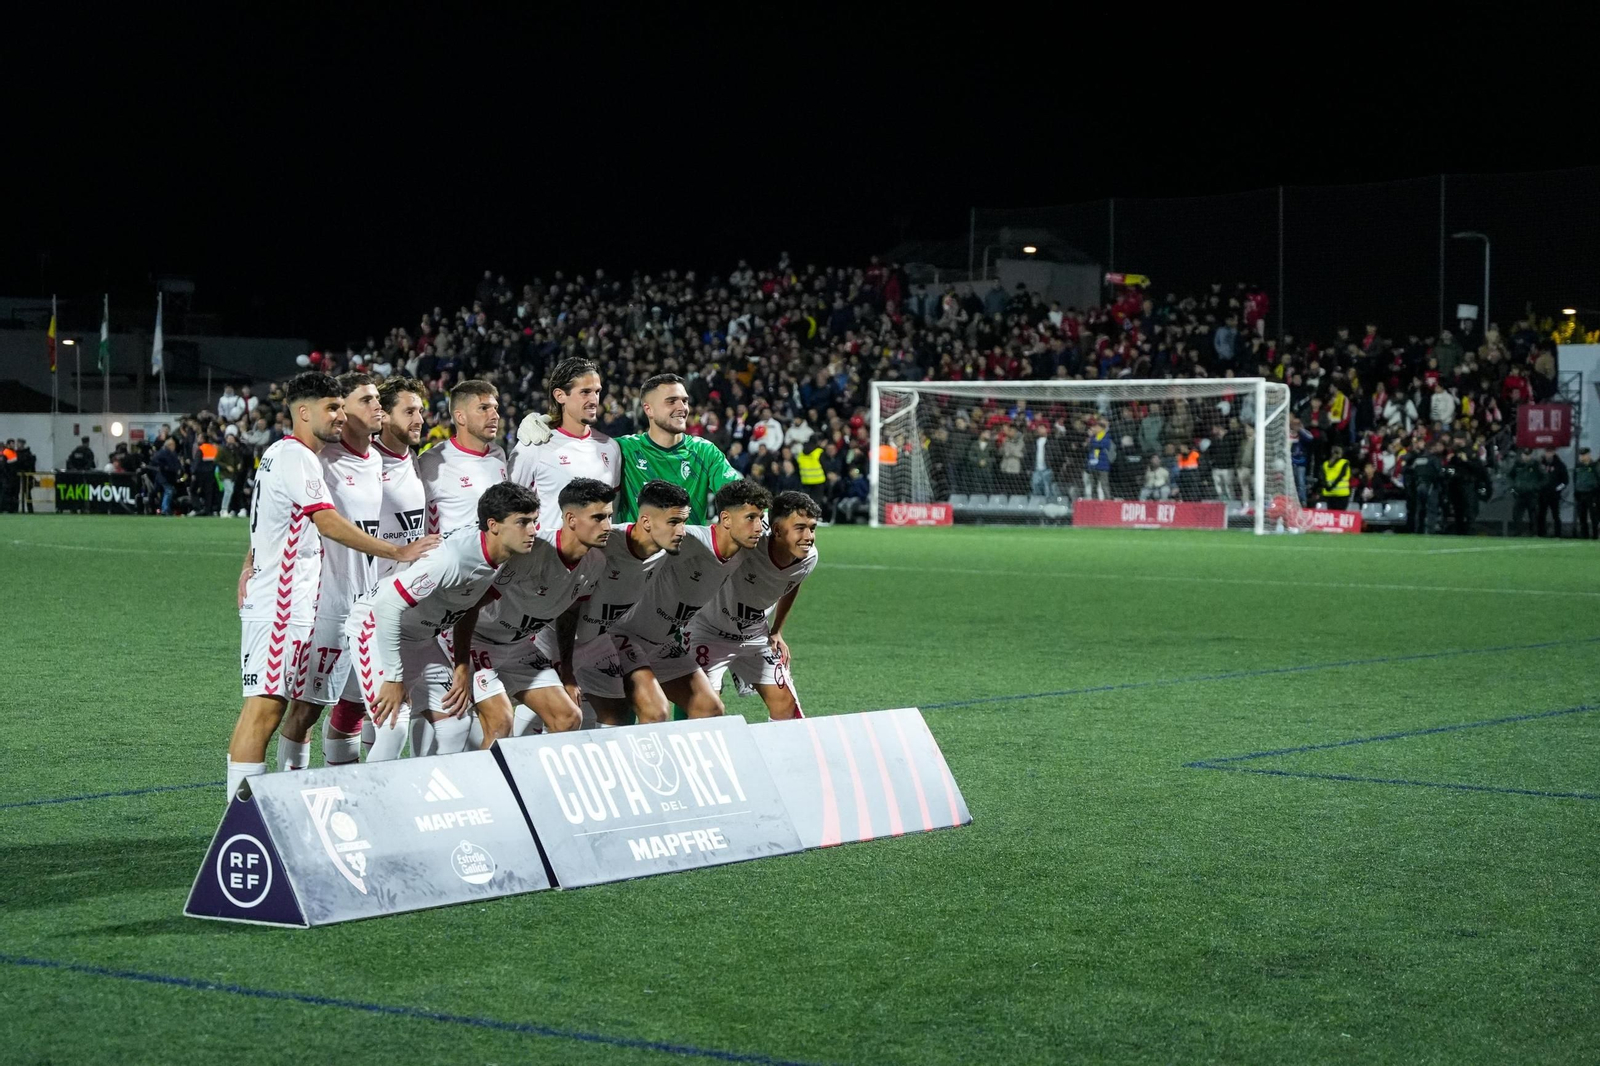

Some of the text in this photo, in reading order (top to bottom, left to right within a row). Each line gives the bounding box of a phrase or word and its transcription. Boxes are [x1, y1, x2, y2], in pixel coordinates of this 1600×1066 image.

[1121, 503, 1176, 522] COPA REY
[383, 531, 408, 540] GRUPO
[317, 646, 343, 675] 17
[470, 650, 492, 671] 16
[695, 644, 710, 667] 8
[538, 730, 747, 825] COPA REY
[660, 800, 687, 812] DEL
[414, 807, 494, 832] MAPFRE
[628, 827, 728, 861] MAPFRE
[457, 852, 486, 865] Estrella
